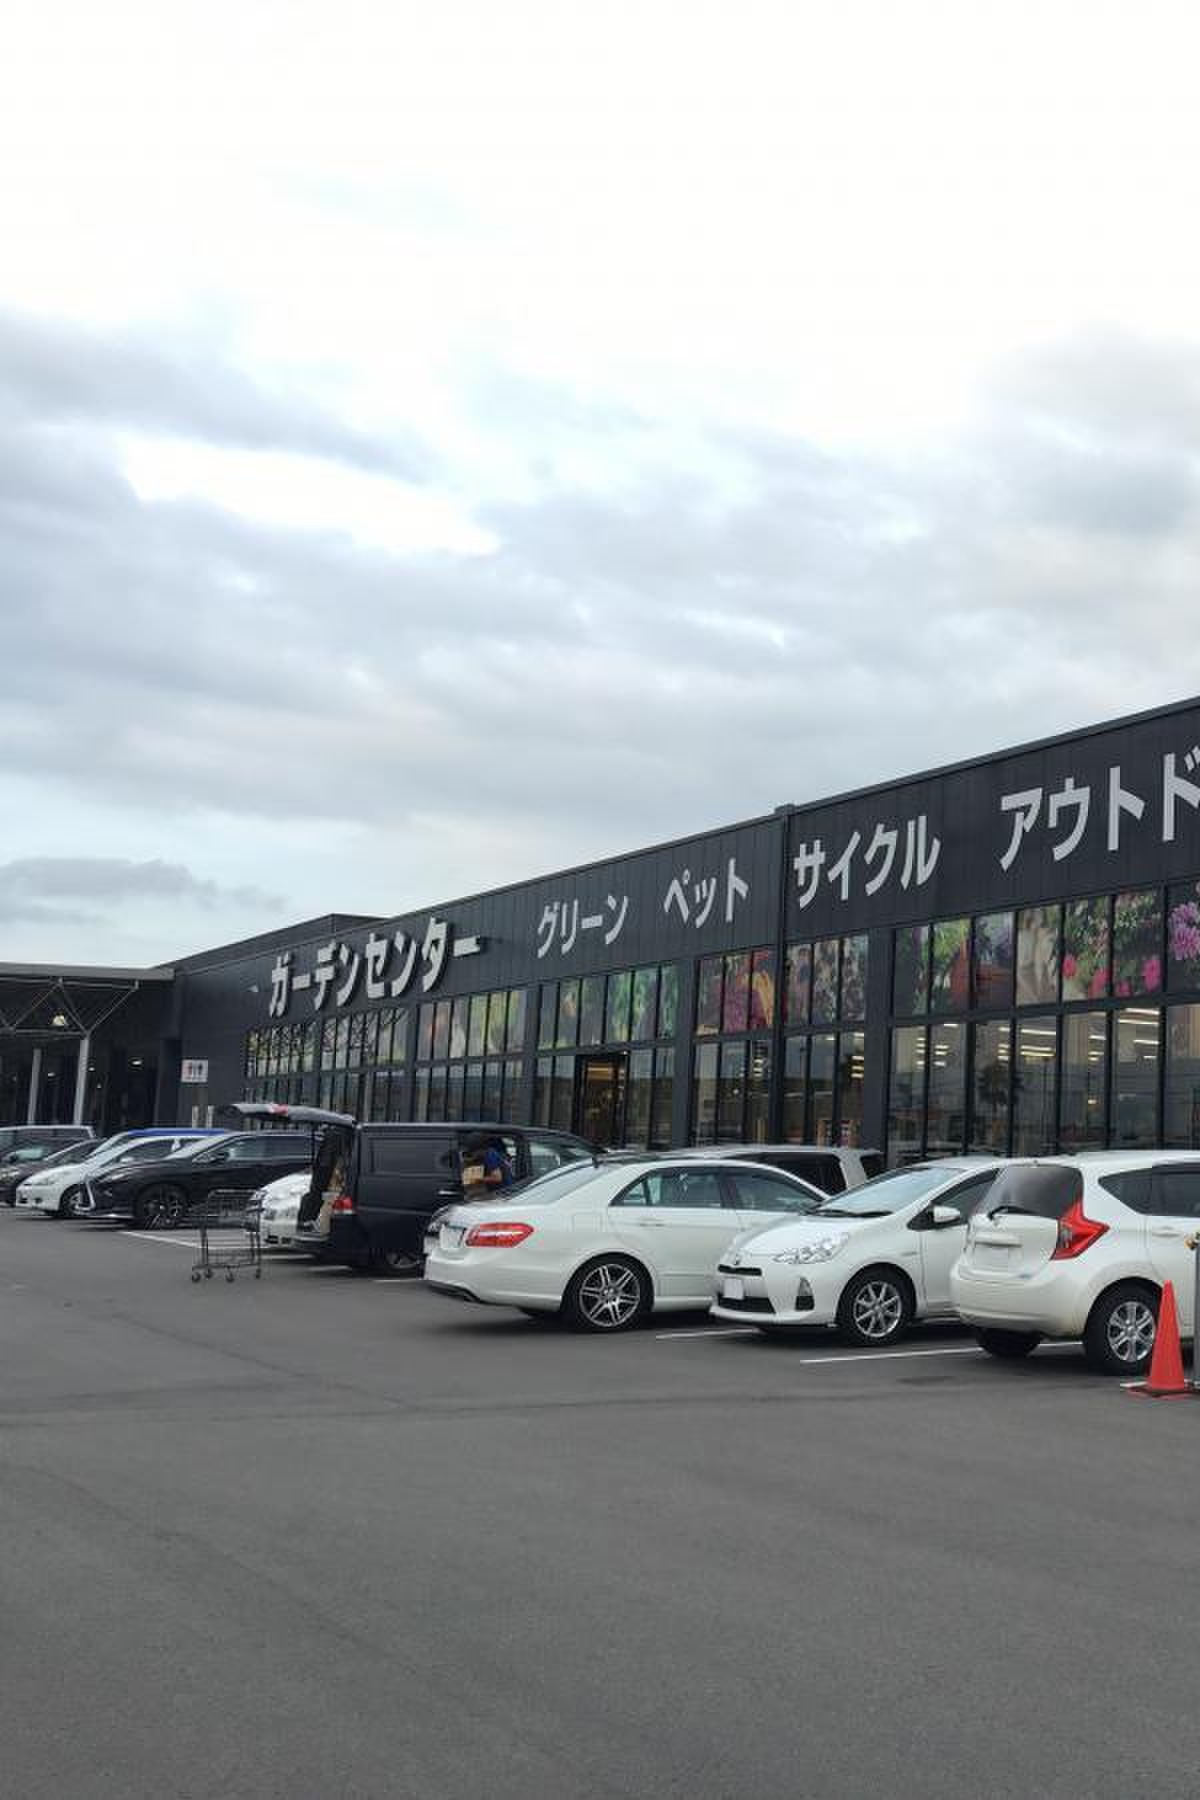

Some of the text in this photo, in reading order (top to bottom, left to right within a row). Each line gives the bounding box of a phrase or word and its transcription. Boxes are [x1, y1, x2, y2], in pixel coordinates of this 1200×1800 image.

[269, 916, 480, 1017] ガーデンセンター
[537, 898, 628, 959] グリーン
[663, 857, 749, 928] ペット
[794, 815, 941, 909] サイクル
